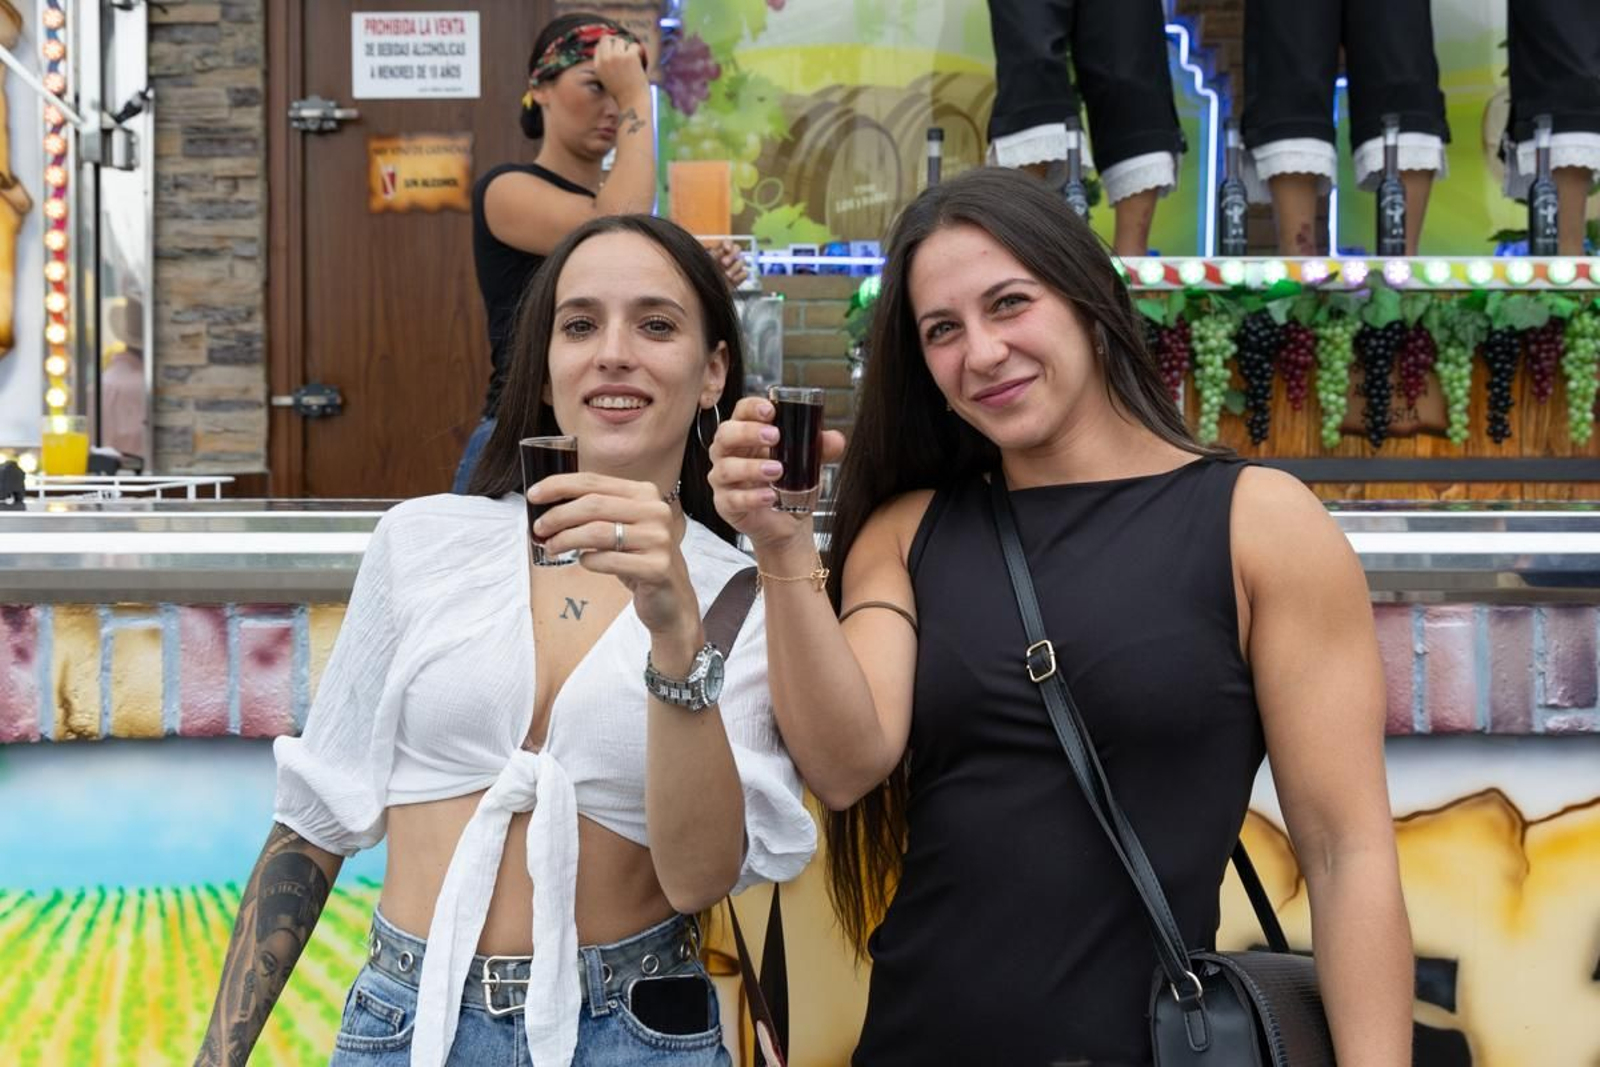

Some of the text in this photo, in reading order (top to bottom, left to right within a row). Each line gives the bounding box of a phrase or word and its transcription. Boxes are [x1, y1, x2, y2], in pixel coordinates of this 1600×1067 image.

[364, 18, 465, 35] PROHIBIDA LA VENTA
[365, 42, 375, 56] DE
[377, 42, 409, 56] BEBIDAS
[370, 65, 376, 79] A
[378, 65, 414, 79] MENORES
[417, 65, 427, 79] DE
[440, 61, 461, 79] AÑOS
[404, 178, 459, 188] SIN ALCOHOL
[559, 596, 590, 621] N
